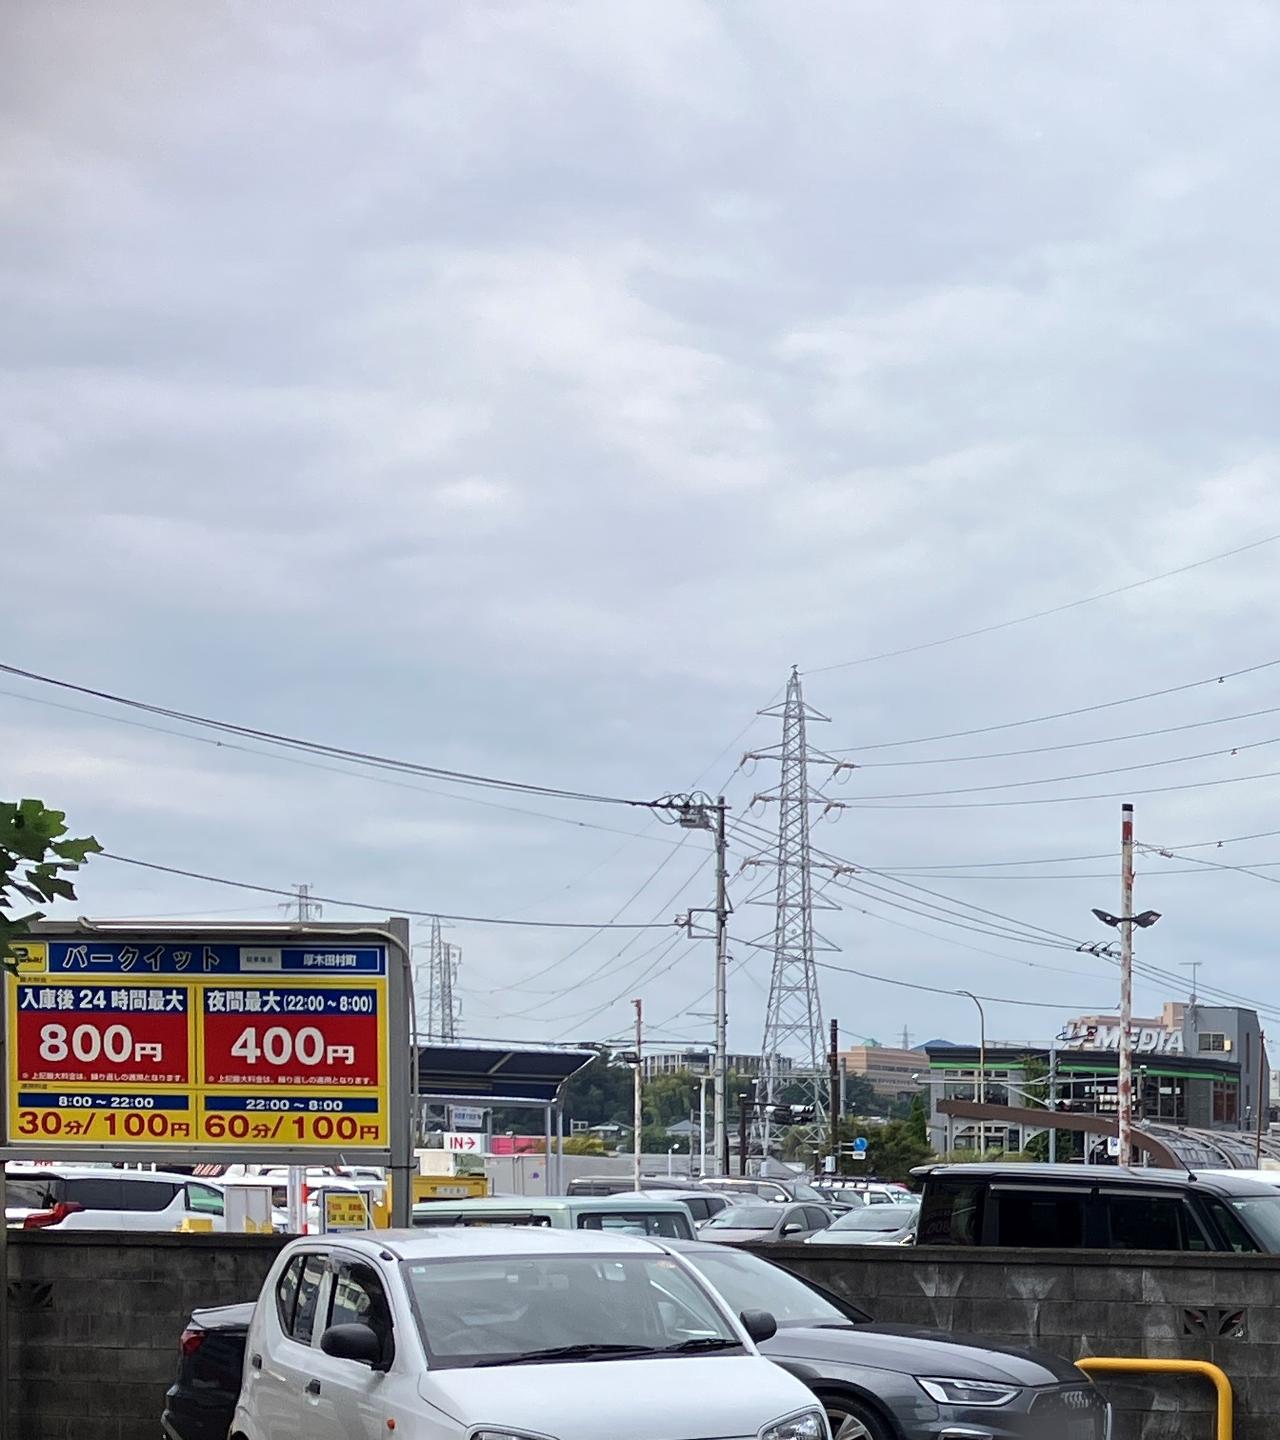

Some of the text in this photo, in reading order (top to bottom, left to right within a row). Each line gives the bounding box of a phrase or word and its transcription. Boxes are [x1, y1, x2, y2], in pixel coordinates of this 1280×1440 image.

[62, 944, 220, 972] パークイット
[79, 990, 107, 1009] 24
[39, 1023, 163, 1063] 800円
[230, 1026, 355, 1065] 400円
[449, 1136, 464, 1150] IN
